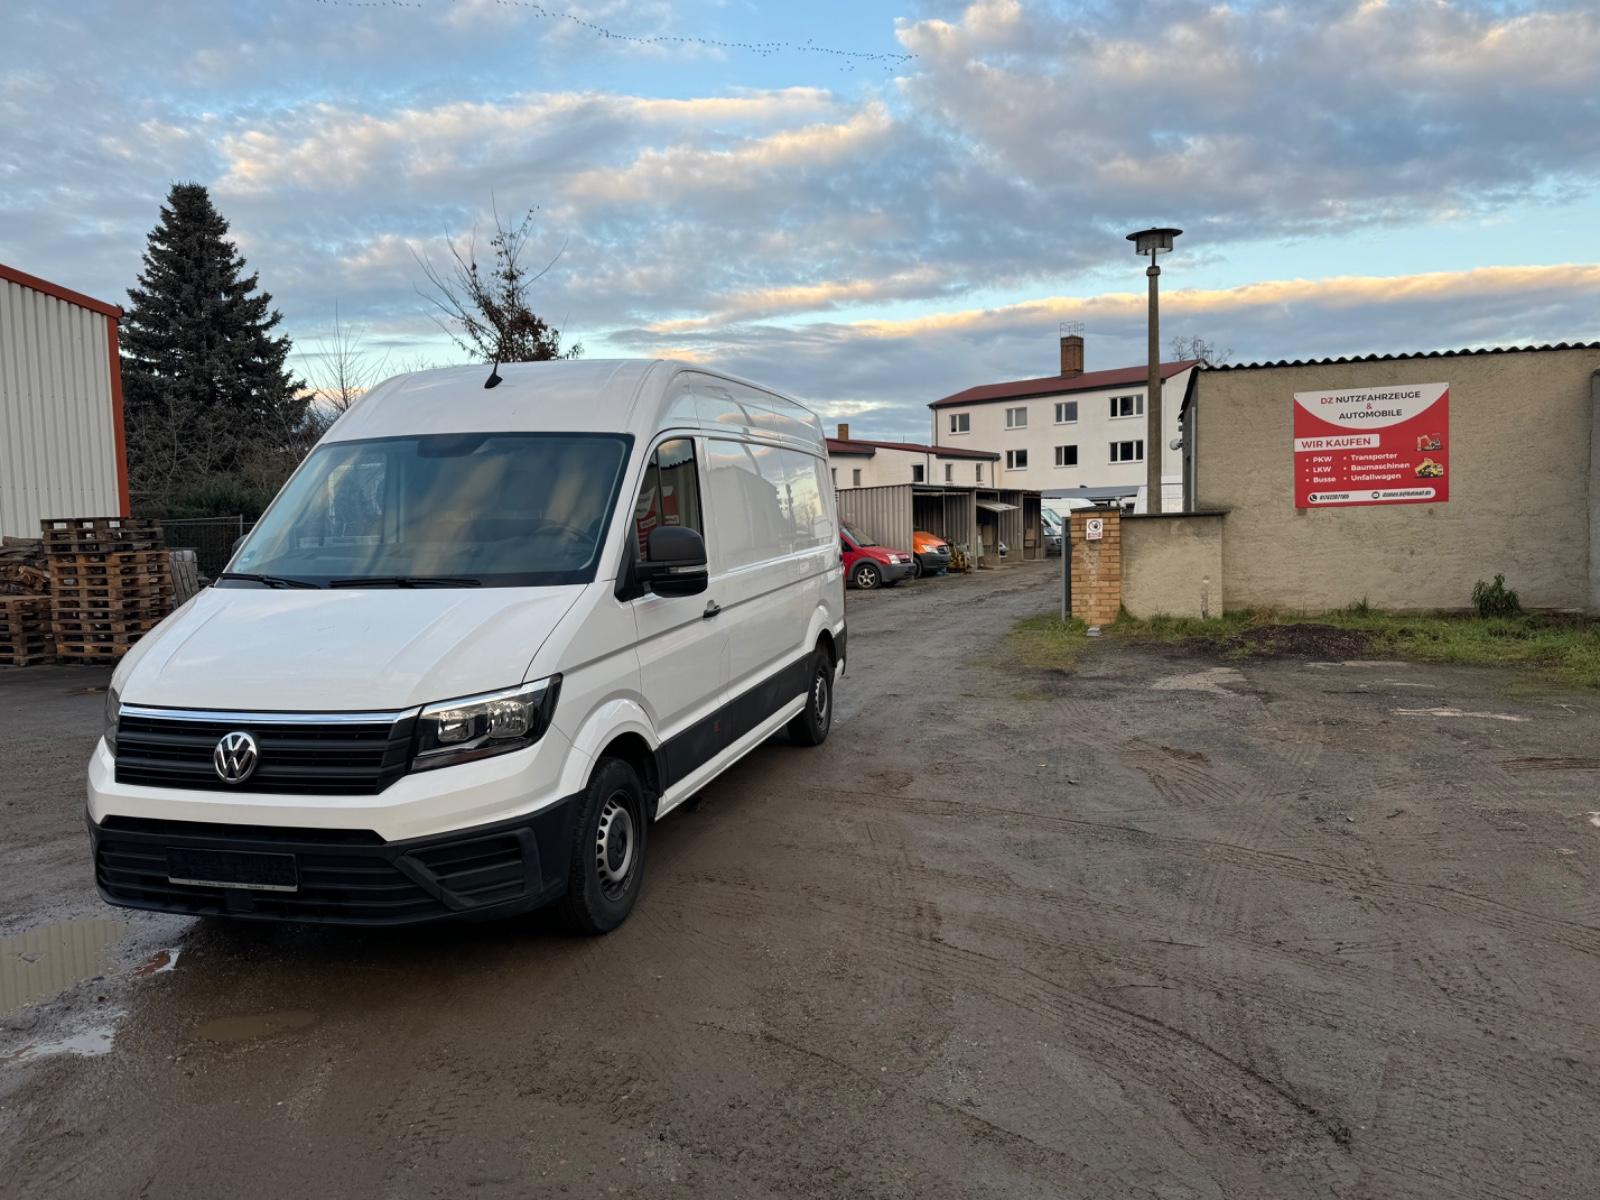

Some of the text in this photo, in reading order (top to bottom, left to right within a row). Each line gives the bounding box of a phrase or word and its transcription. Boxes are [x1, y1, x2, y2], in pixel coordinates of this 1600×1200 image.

[1320, 391, 1421, 405] DZ NUTZFAHRZEUGE
[1366, 402, 1373, 410] &
[1338, 409, 1403, 420] AUTOMOBILE
[1301, 437, 1371, 449] WIR KAUFEN
[1350, 452, 1399, 461] Transporter
[1350, 462, 1410, 471] Baumaschinen
[1312, 476, 1337, 484] Busse
[1350, 473, 1402, 482] Unfallwagen
[213, 731, 258, 784] VW
